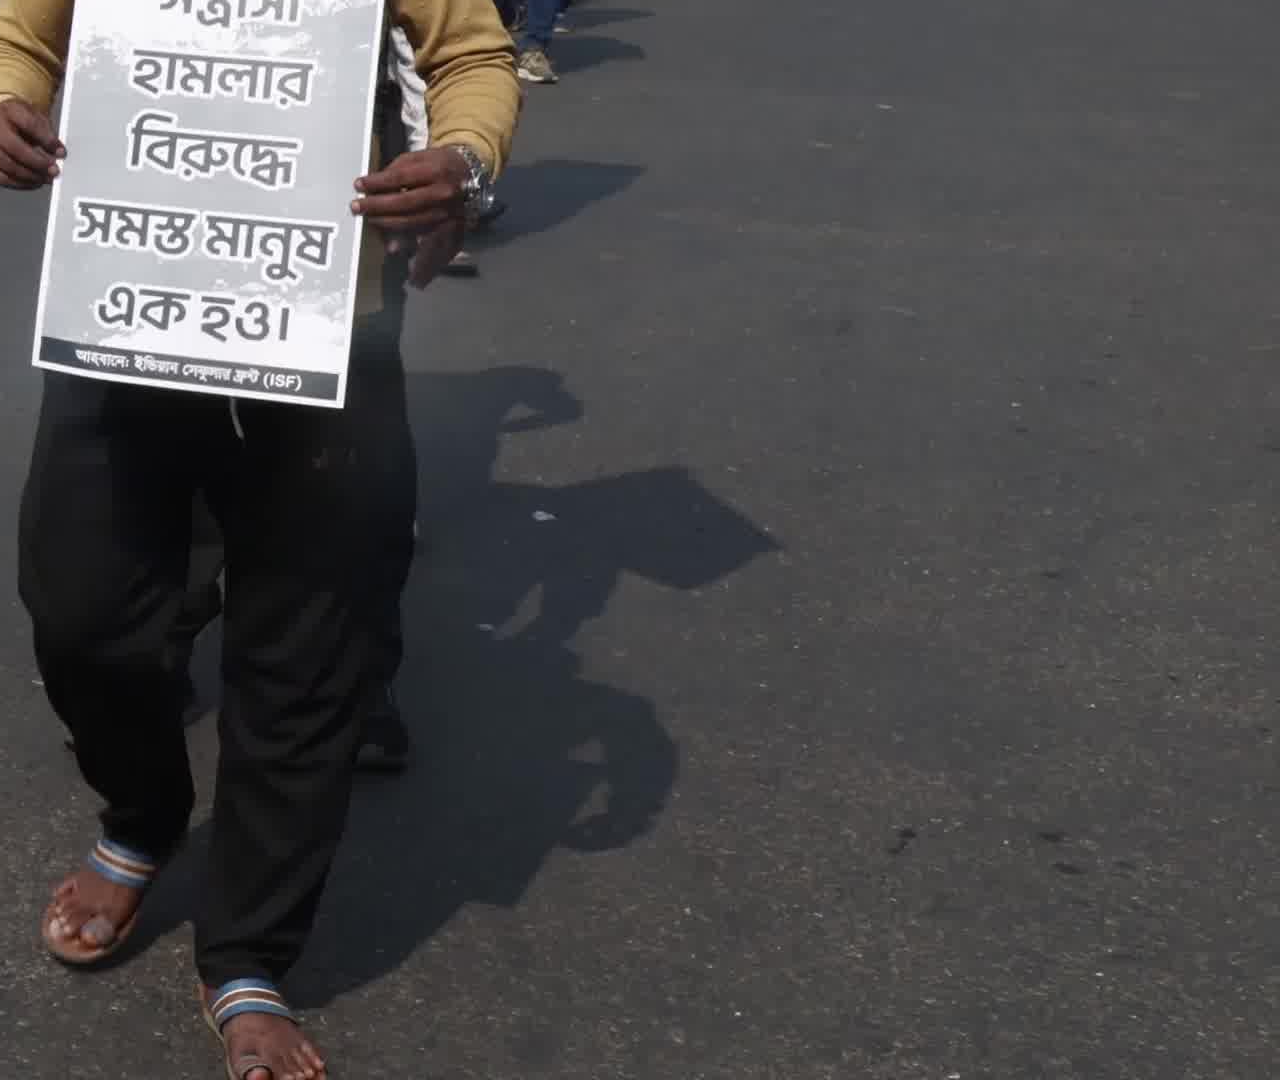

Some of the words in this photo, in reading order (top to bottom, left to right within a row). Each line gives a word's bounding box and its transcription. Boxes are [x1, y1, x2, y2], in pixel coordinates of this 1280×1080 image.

[133, 49, 313, 105] হামলার
[131, 113, 298, 186] বিরুদ্ধে
[78, 201, 196, 255] সমস্ত
[206, 216, 334, 280] মানুষ
[98, 286, 191, 331] এক
[263, 371, 303, 392] (ISF)
